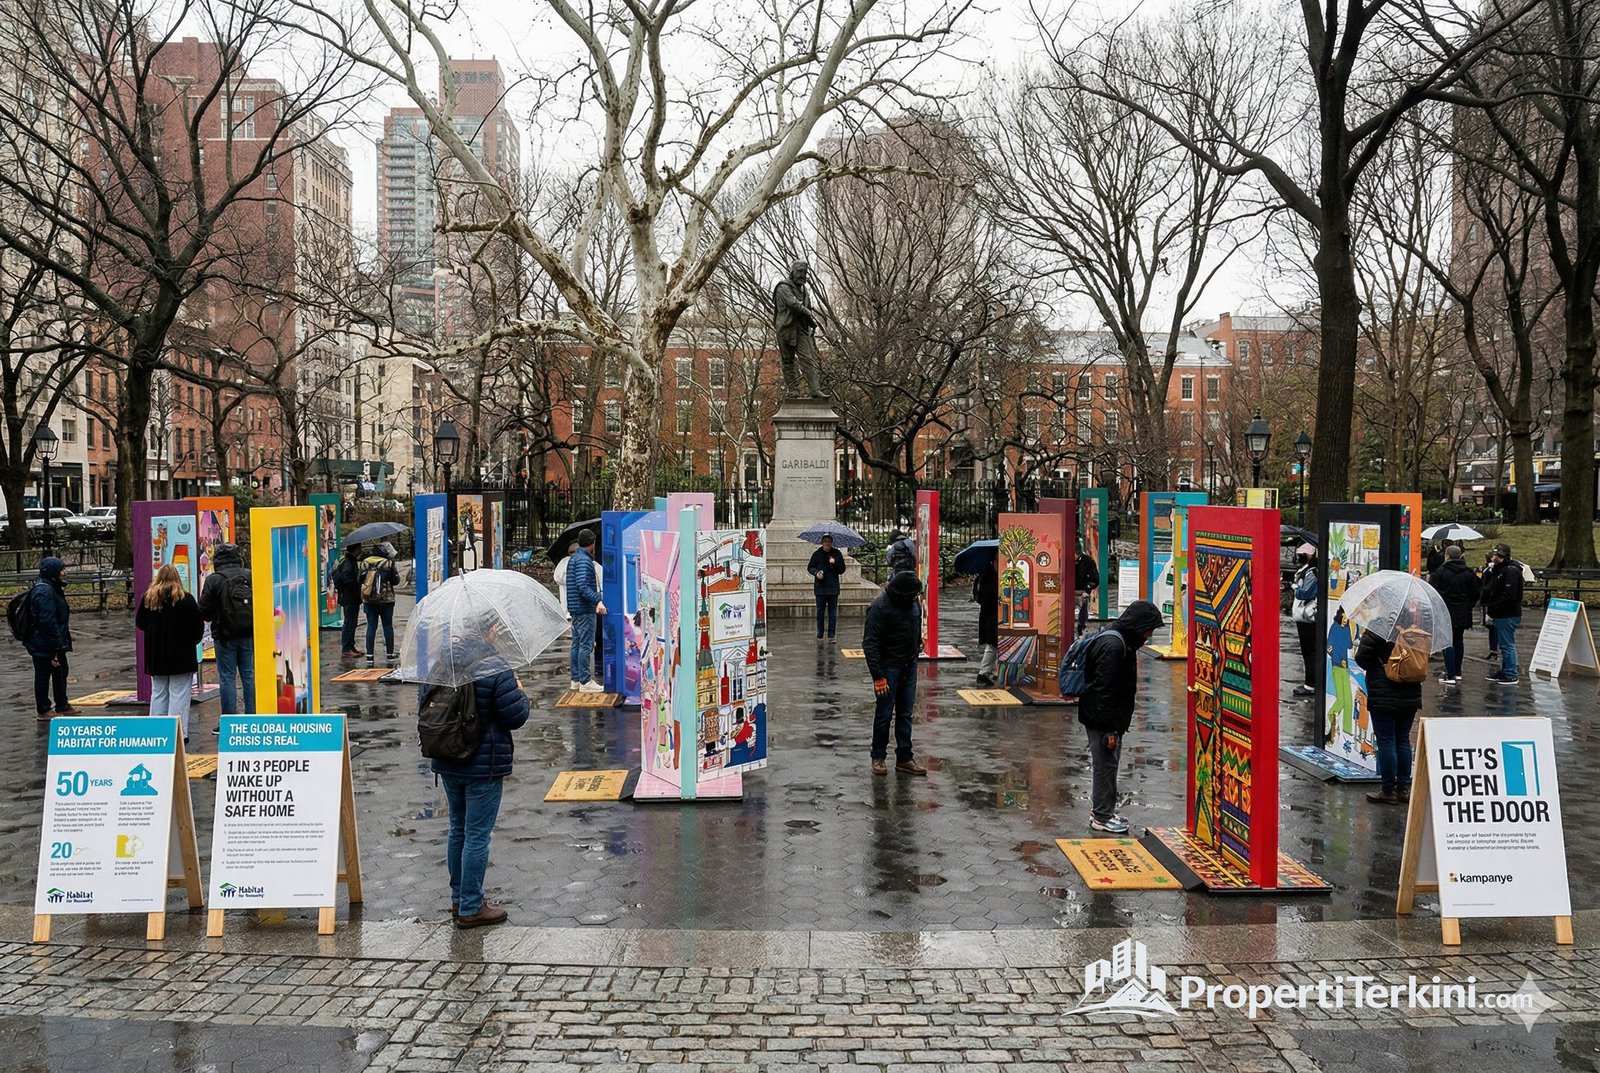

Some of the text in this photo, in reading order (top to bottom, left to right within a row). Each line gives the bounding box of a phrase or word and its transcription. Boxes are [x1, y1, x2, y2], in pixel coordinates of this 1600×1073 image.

[781, 459, 829, 469] GARIBALDI
[57, 725, 117, 736] 50 YEARS OF
[229, 722, 332, 734] THE GLOBAL HOUSING
[57, 737, 168, 748] HABITAT FOR HUMANITY
[228, 735, 299, 746] CRISIS IS REAL
[1438, 747, 1498, 770] LET'S
[227, 760, 233, 773] 1
[237, 760, 250, 773] IN
[253, 760, 261, 773] 3
[263, 759, 310, 772] PEOPLE
[56, 770, 113, 797] 50 YEARS
[227, 774, 282, 788] WAKE UP
[1441, 774, 1499, 797] OPEN
[226, 789, 294, 803] WITHOUT A
[224, 804, 295, 818] SAFE HOME
[1443, 800, 1551, 823] THE DOOR
[50, 841, 73, 859] 20
[1459, 873, 1513, 885] kampanye
[66, 890, 94, 899] Habitat
[238, 885, 264, 894] Habitat
